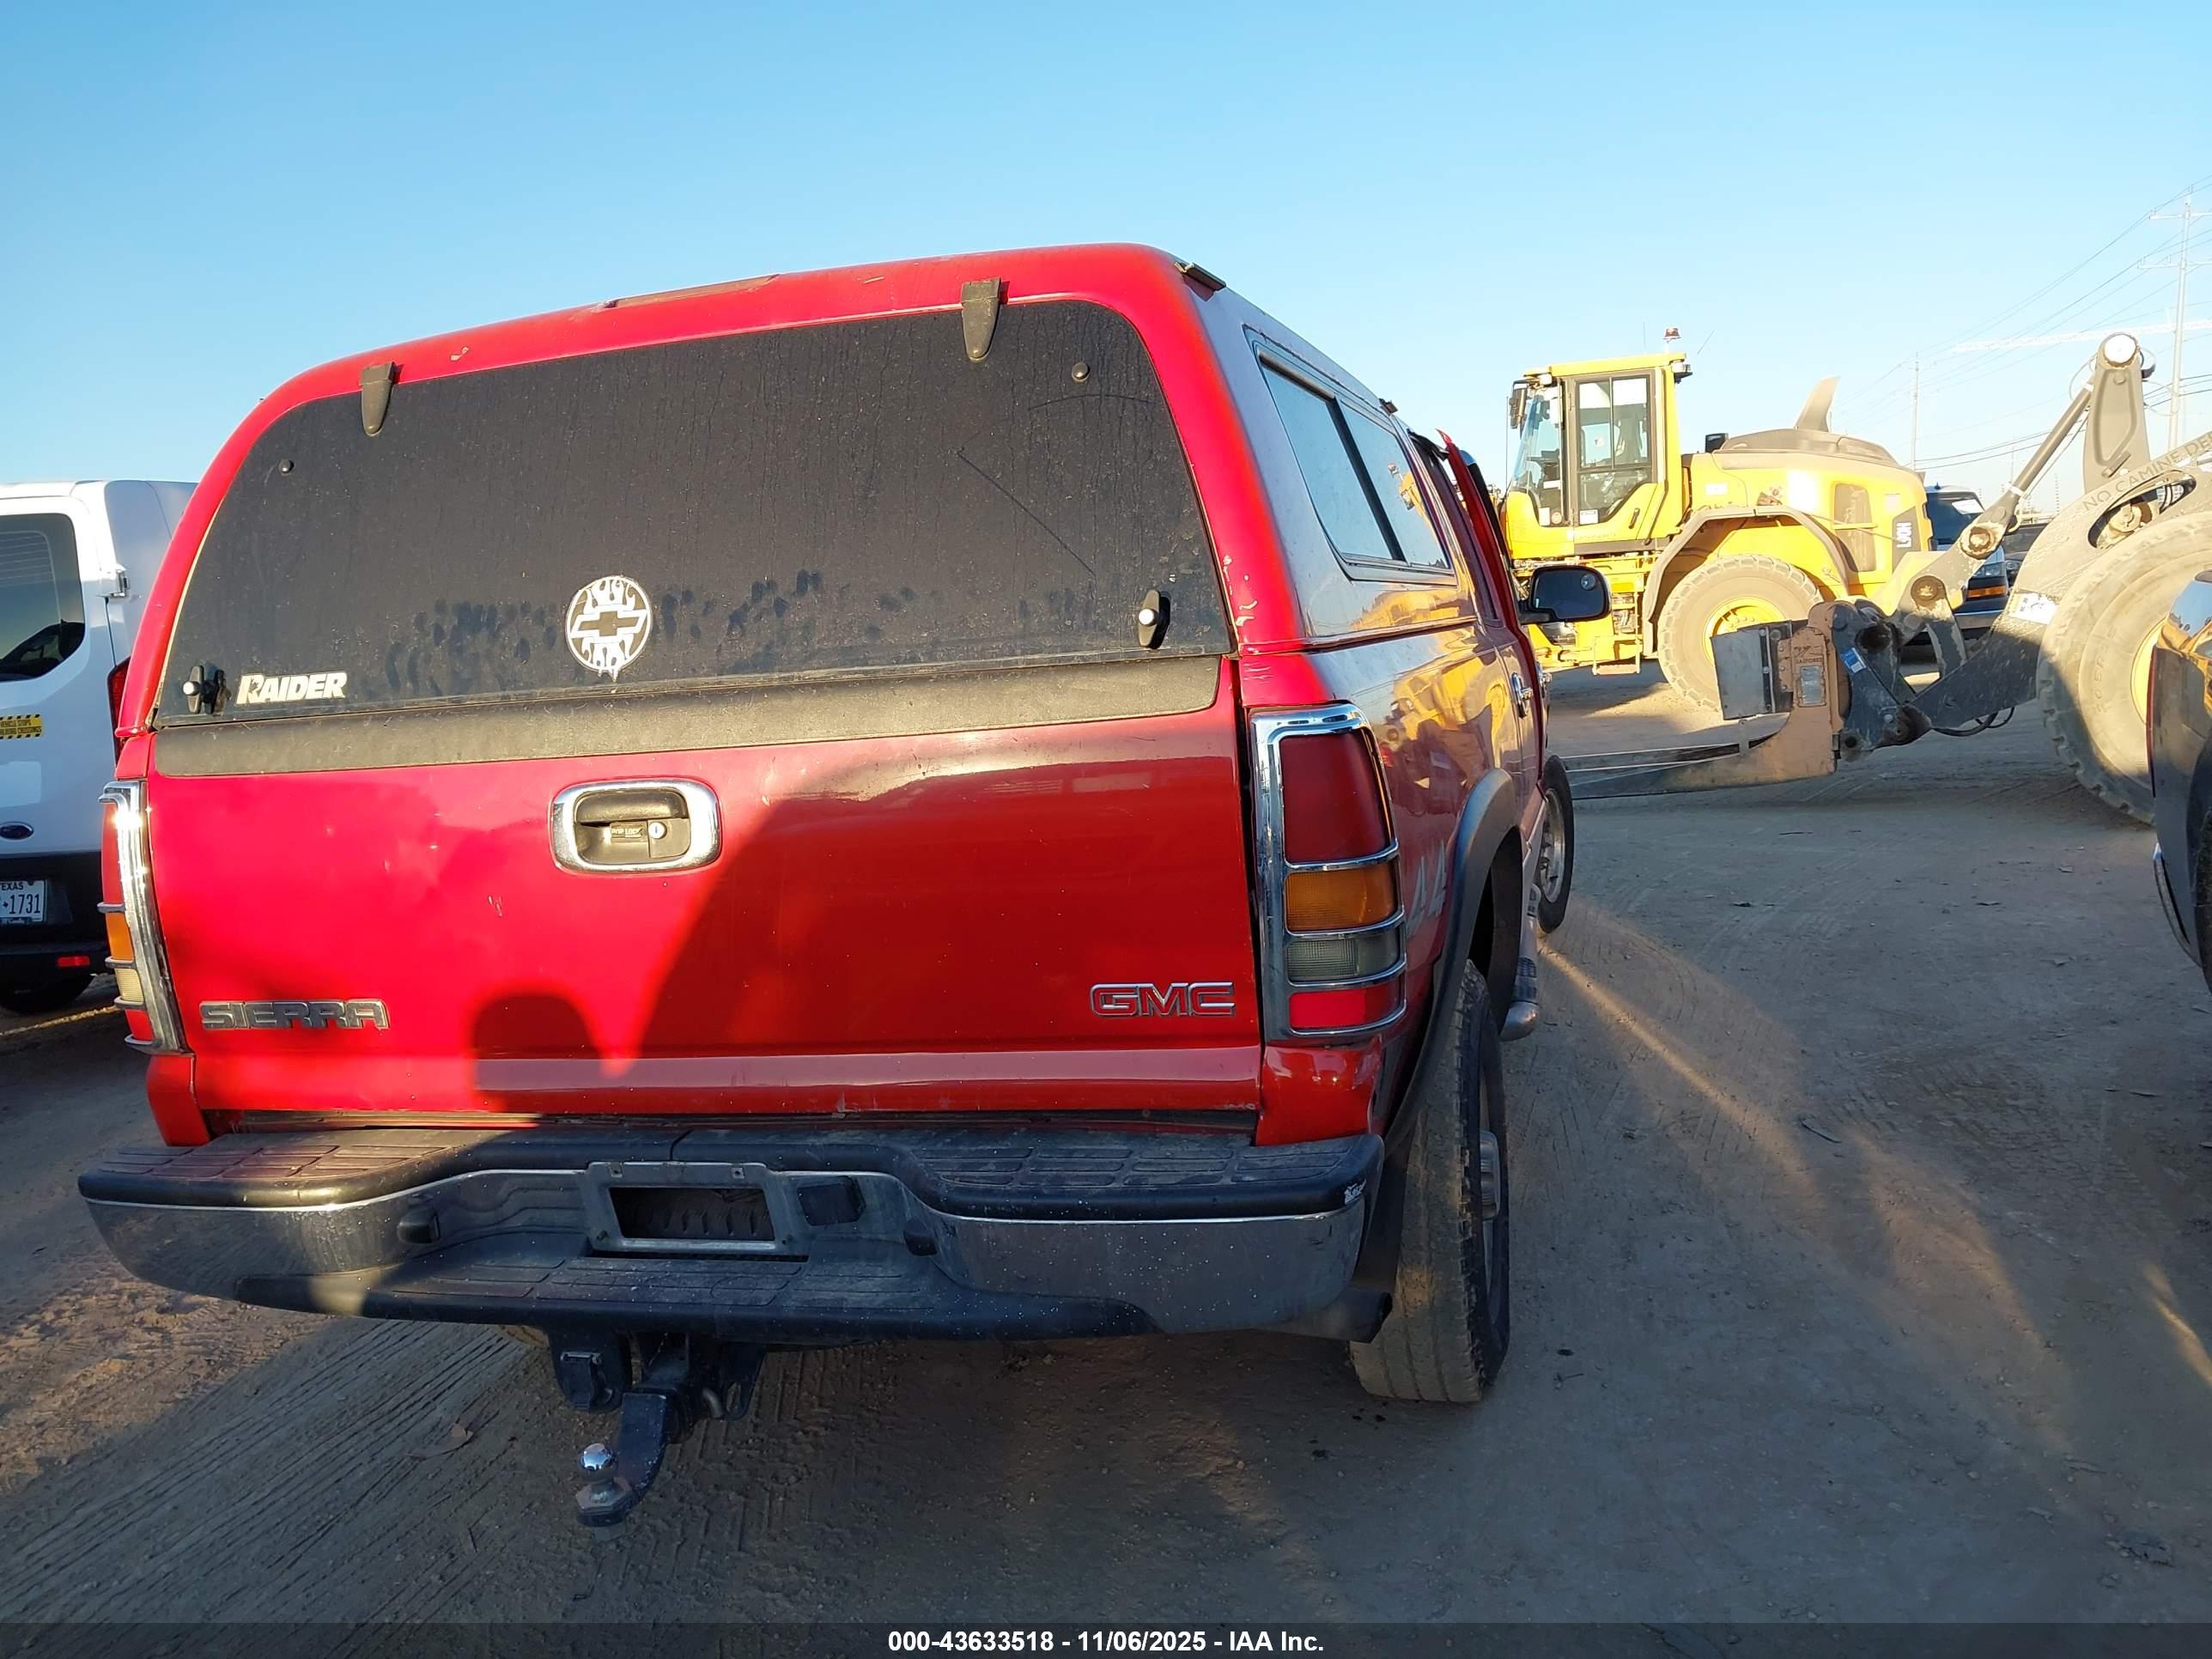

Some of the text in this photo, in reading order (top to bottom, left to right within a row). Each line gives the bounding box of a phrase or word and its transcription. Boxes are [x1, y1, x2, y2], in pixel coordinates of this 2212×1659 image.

[2082, 490, 2111, 510] NO
[2116, 451, 2179, 493] CAMINE
[235, 672, 348, 705] RAIDER
[0, 881, 24, 891] EXAS
[198, 999, 390, 1030] SIERRA
[1091, 981, 1236, 1018] GMC
